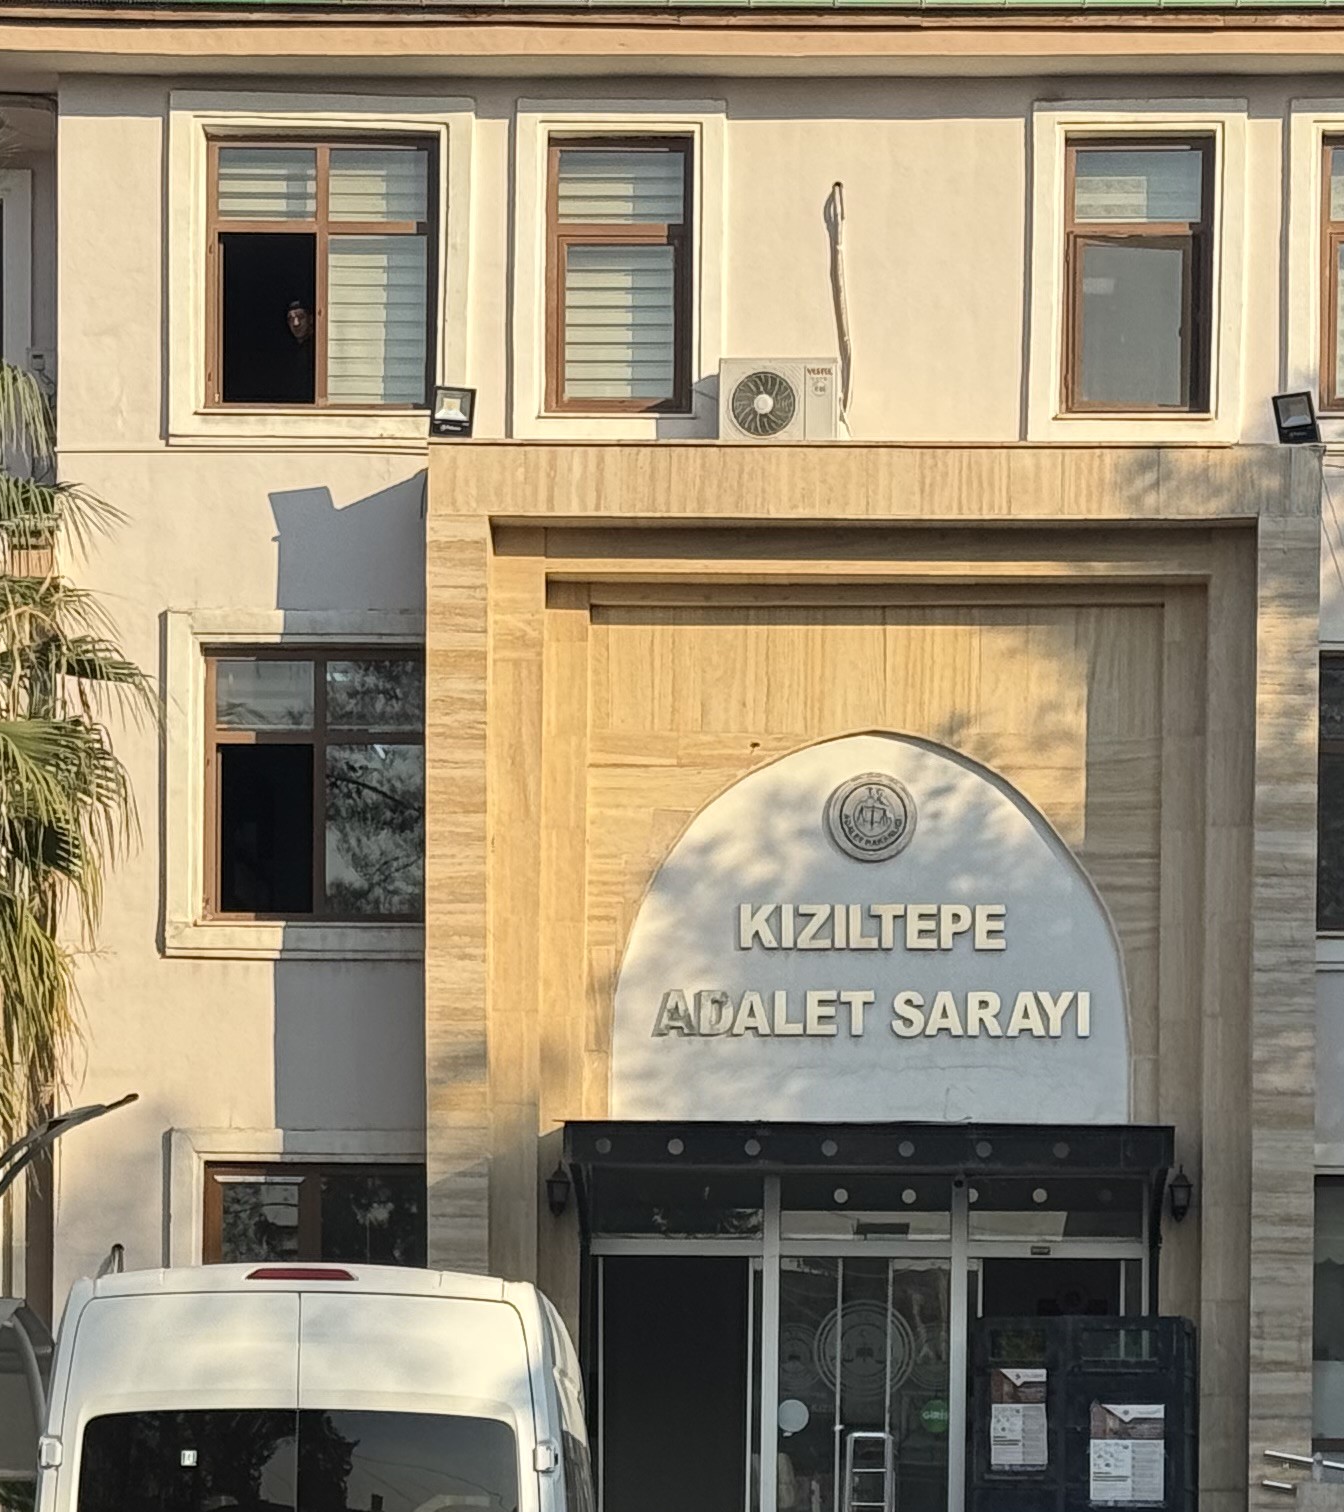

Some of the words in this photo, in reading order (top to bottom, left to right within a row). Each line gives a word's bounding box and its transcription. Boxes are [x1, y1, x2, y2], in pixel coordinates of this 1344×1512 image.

[739, 903, 1007, 951] KIZILTEPE
[652, 989, 875, 1038] ADALET
[891, 990, 1090, 1038] SARAYI
